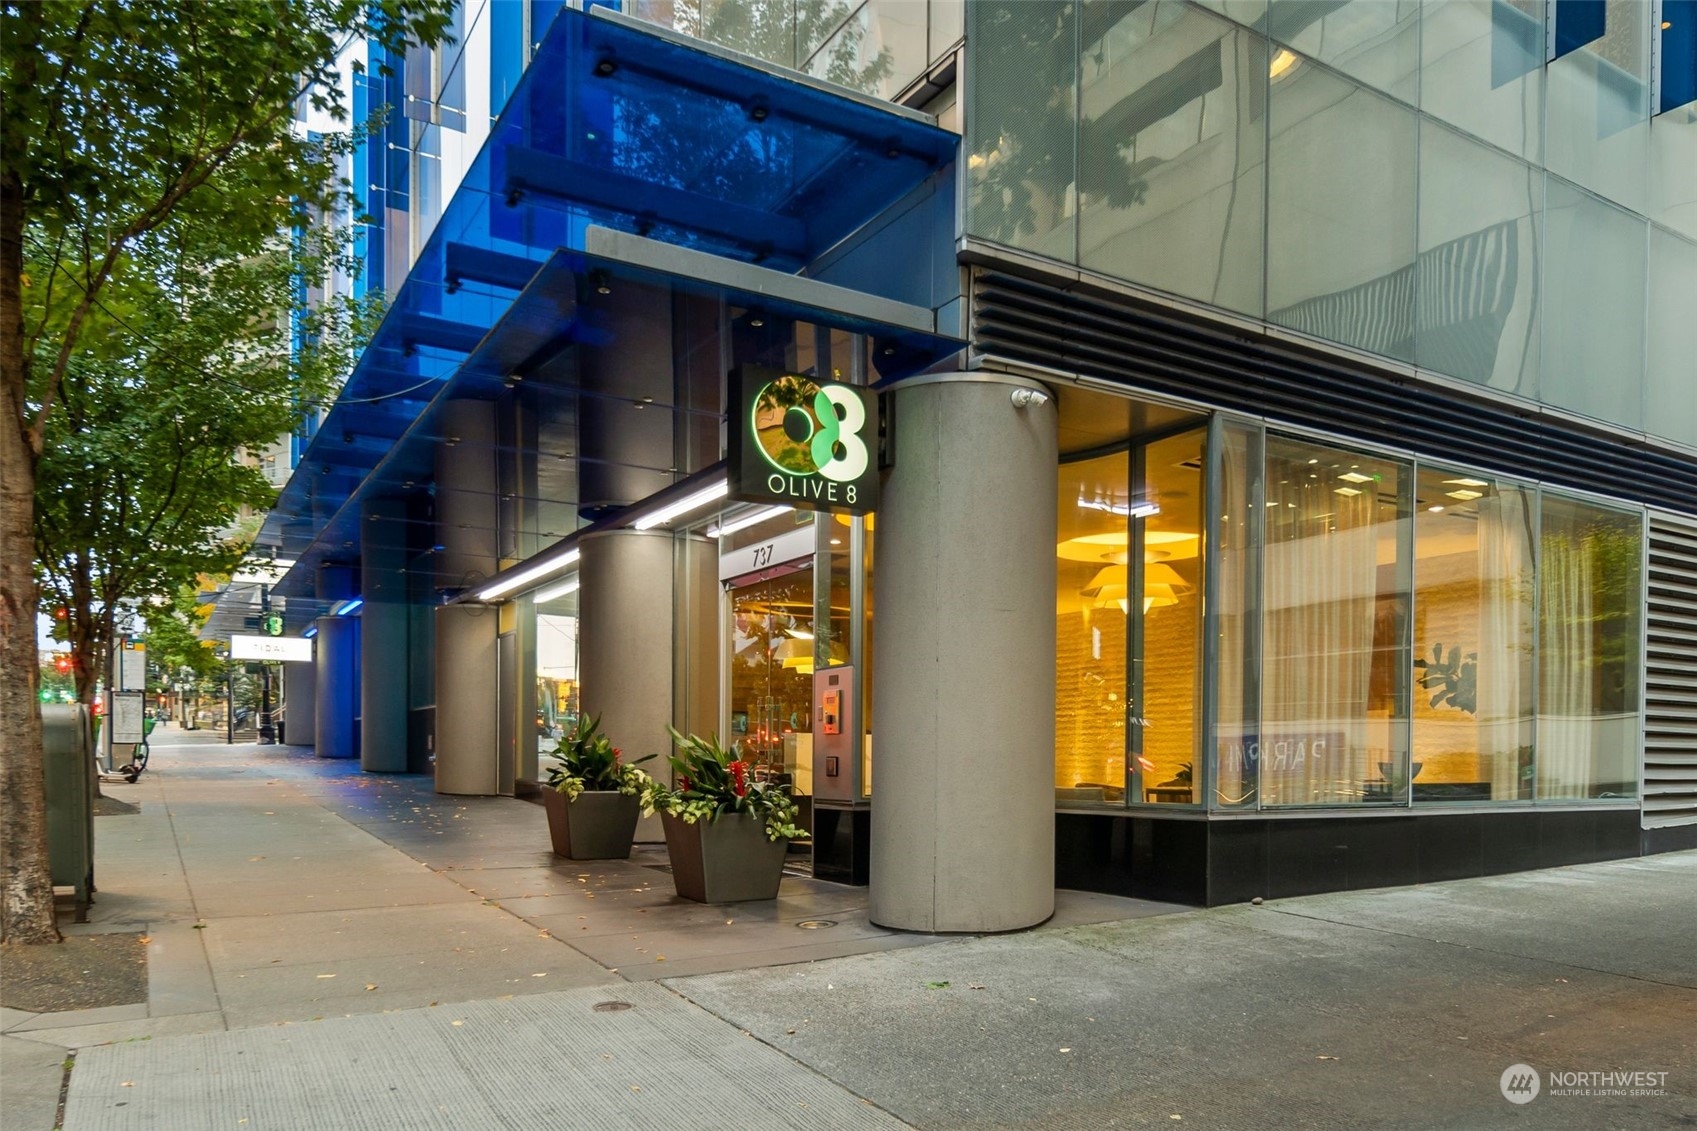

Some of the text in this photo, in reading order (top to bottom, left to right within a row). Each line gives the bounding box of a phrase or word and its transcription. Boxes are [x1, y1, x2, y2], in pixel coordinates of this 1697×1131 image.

[768, 474, 857, 504] OLIVE 8
[753, 544, 774, 567] 737
